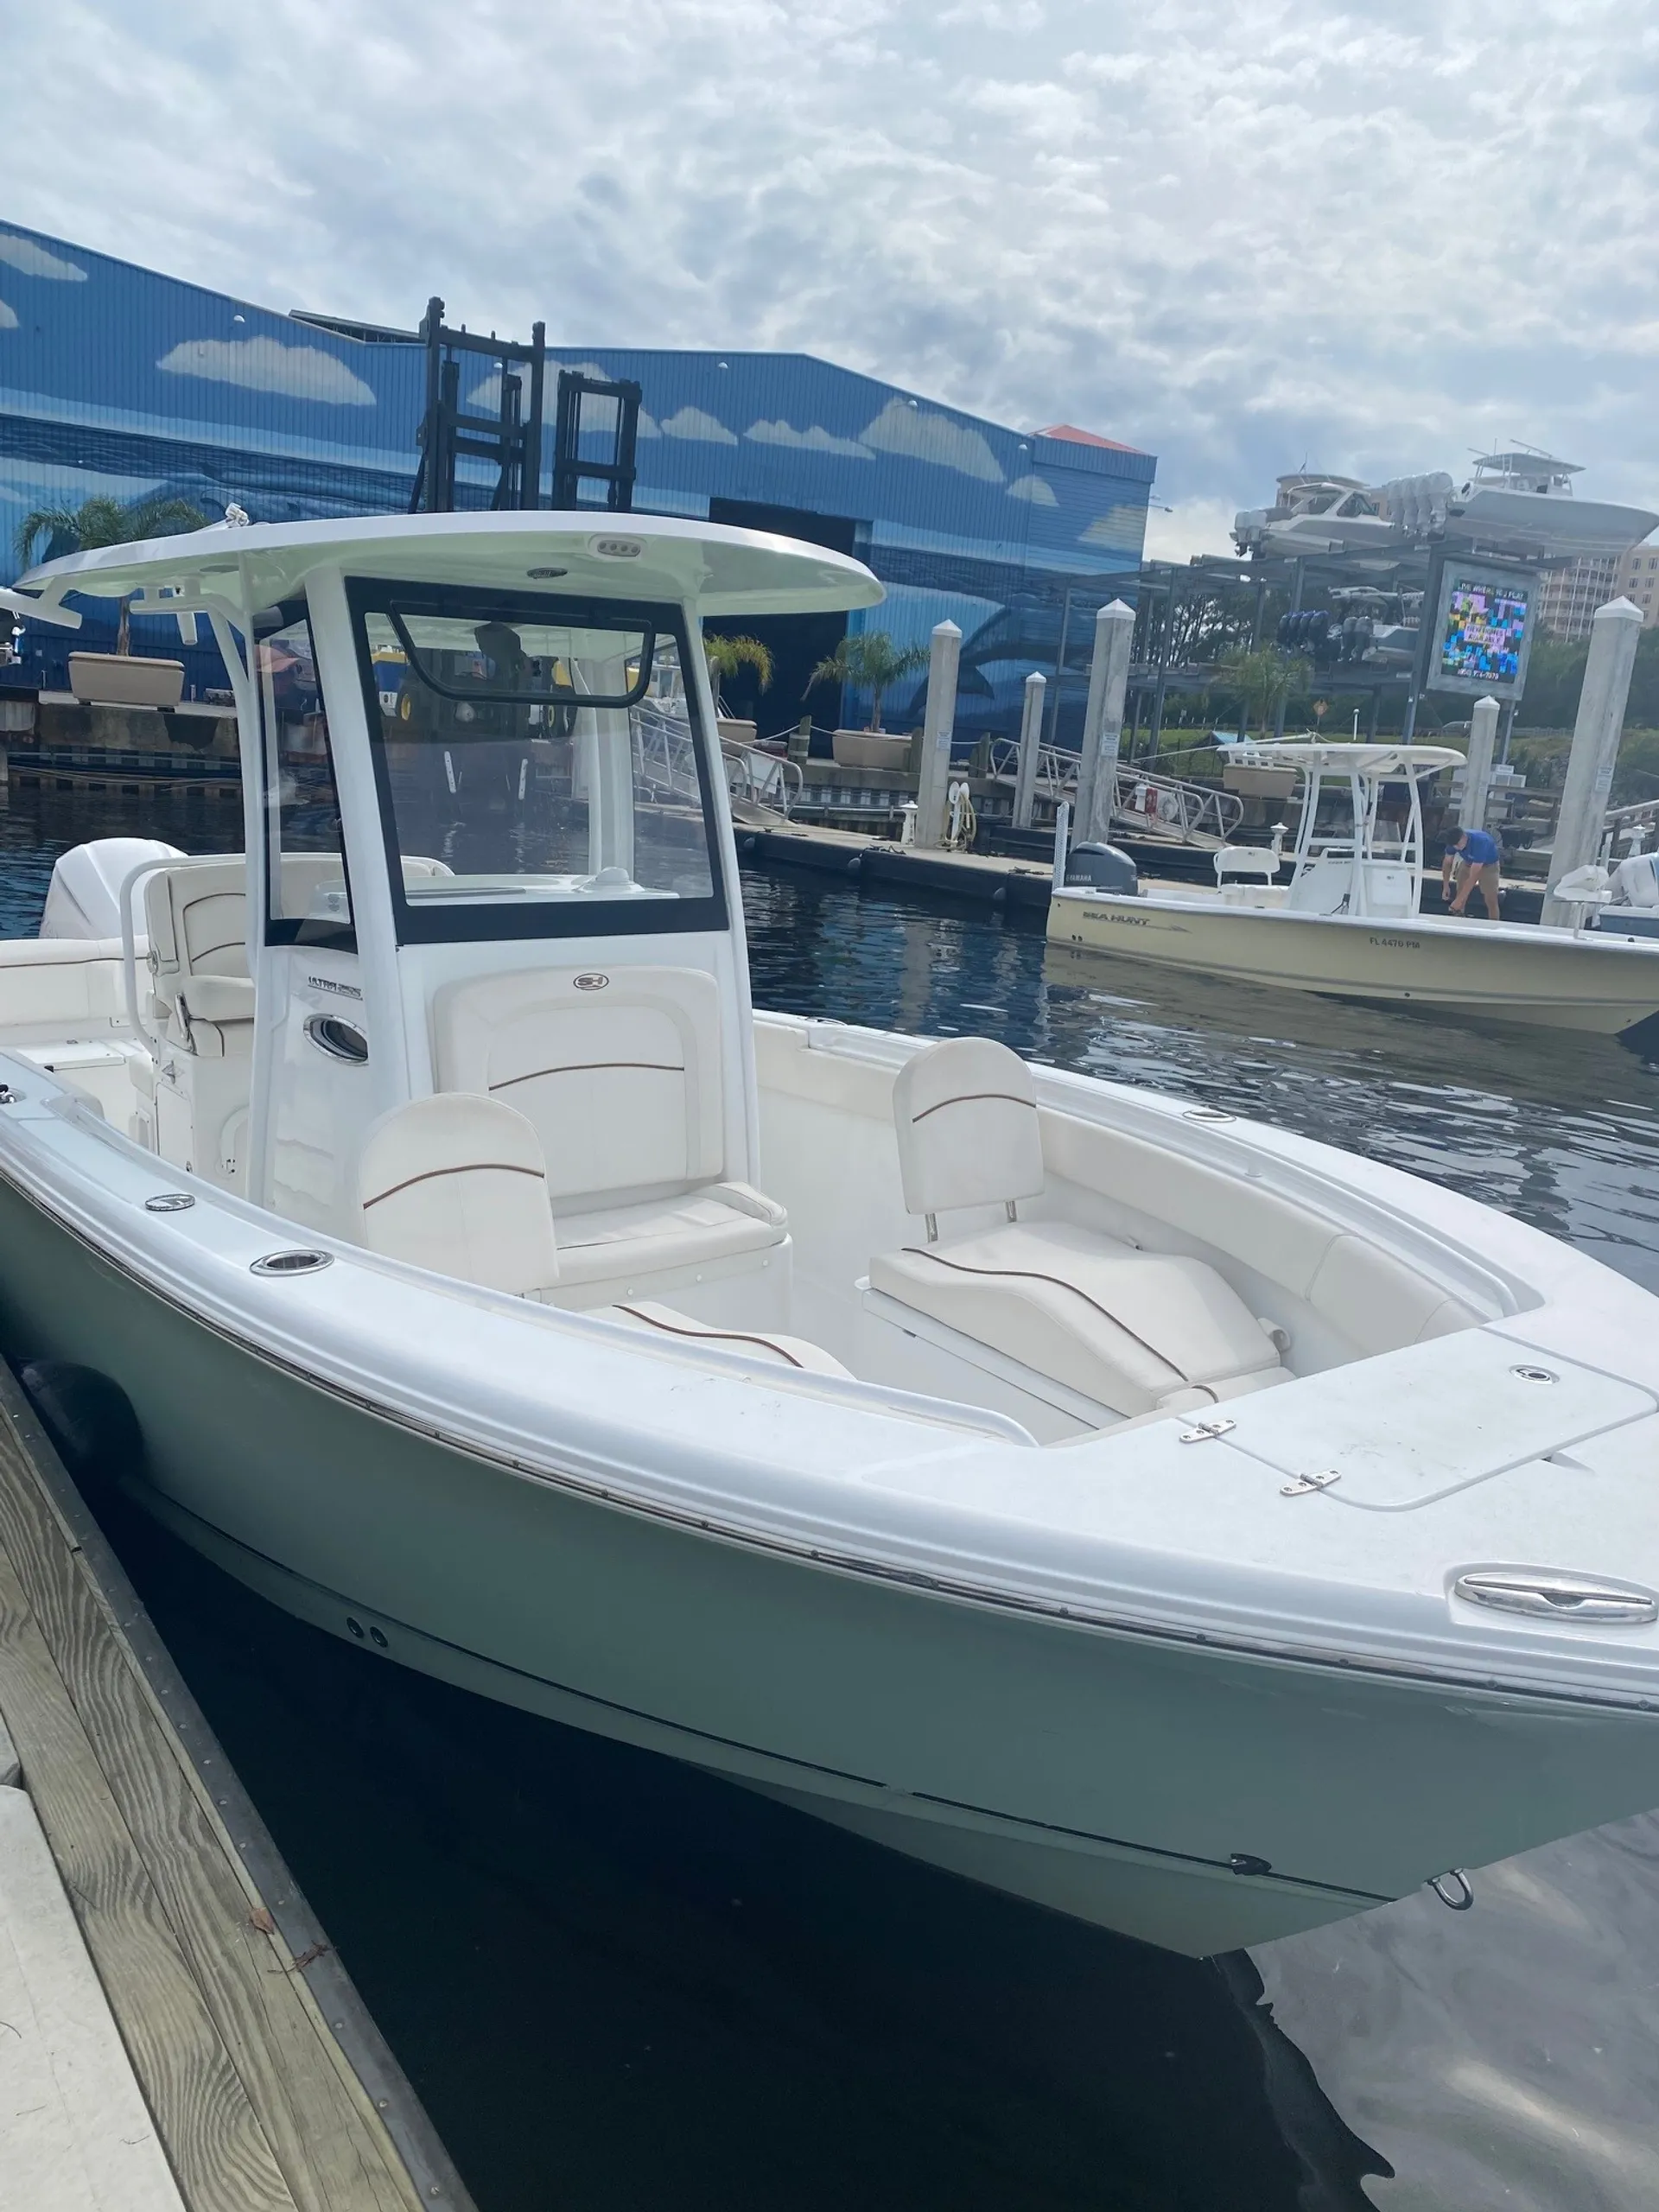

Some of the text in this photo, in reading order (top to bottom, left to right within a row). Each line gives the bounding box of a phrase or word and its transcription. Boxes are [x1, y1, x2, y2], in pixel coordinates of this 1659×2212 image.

[1083, 912, 1150, 925] SEA HUNT
[1370, 938, 1380, 946] FL
[308, 976, 336, 991] ULTRA
